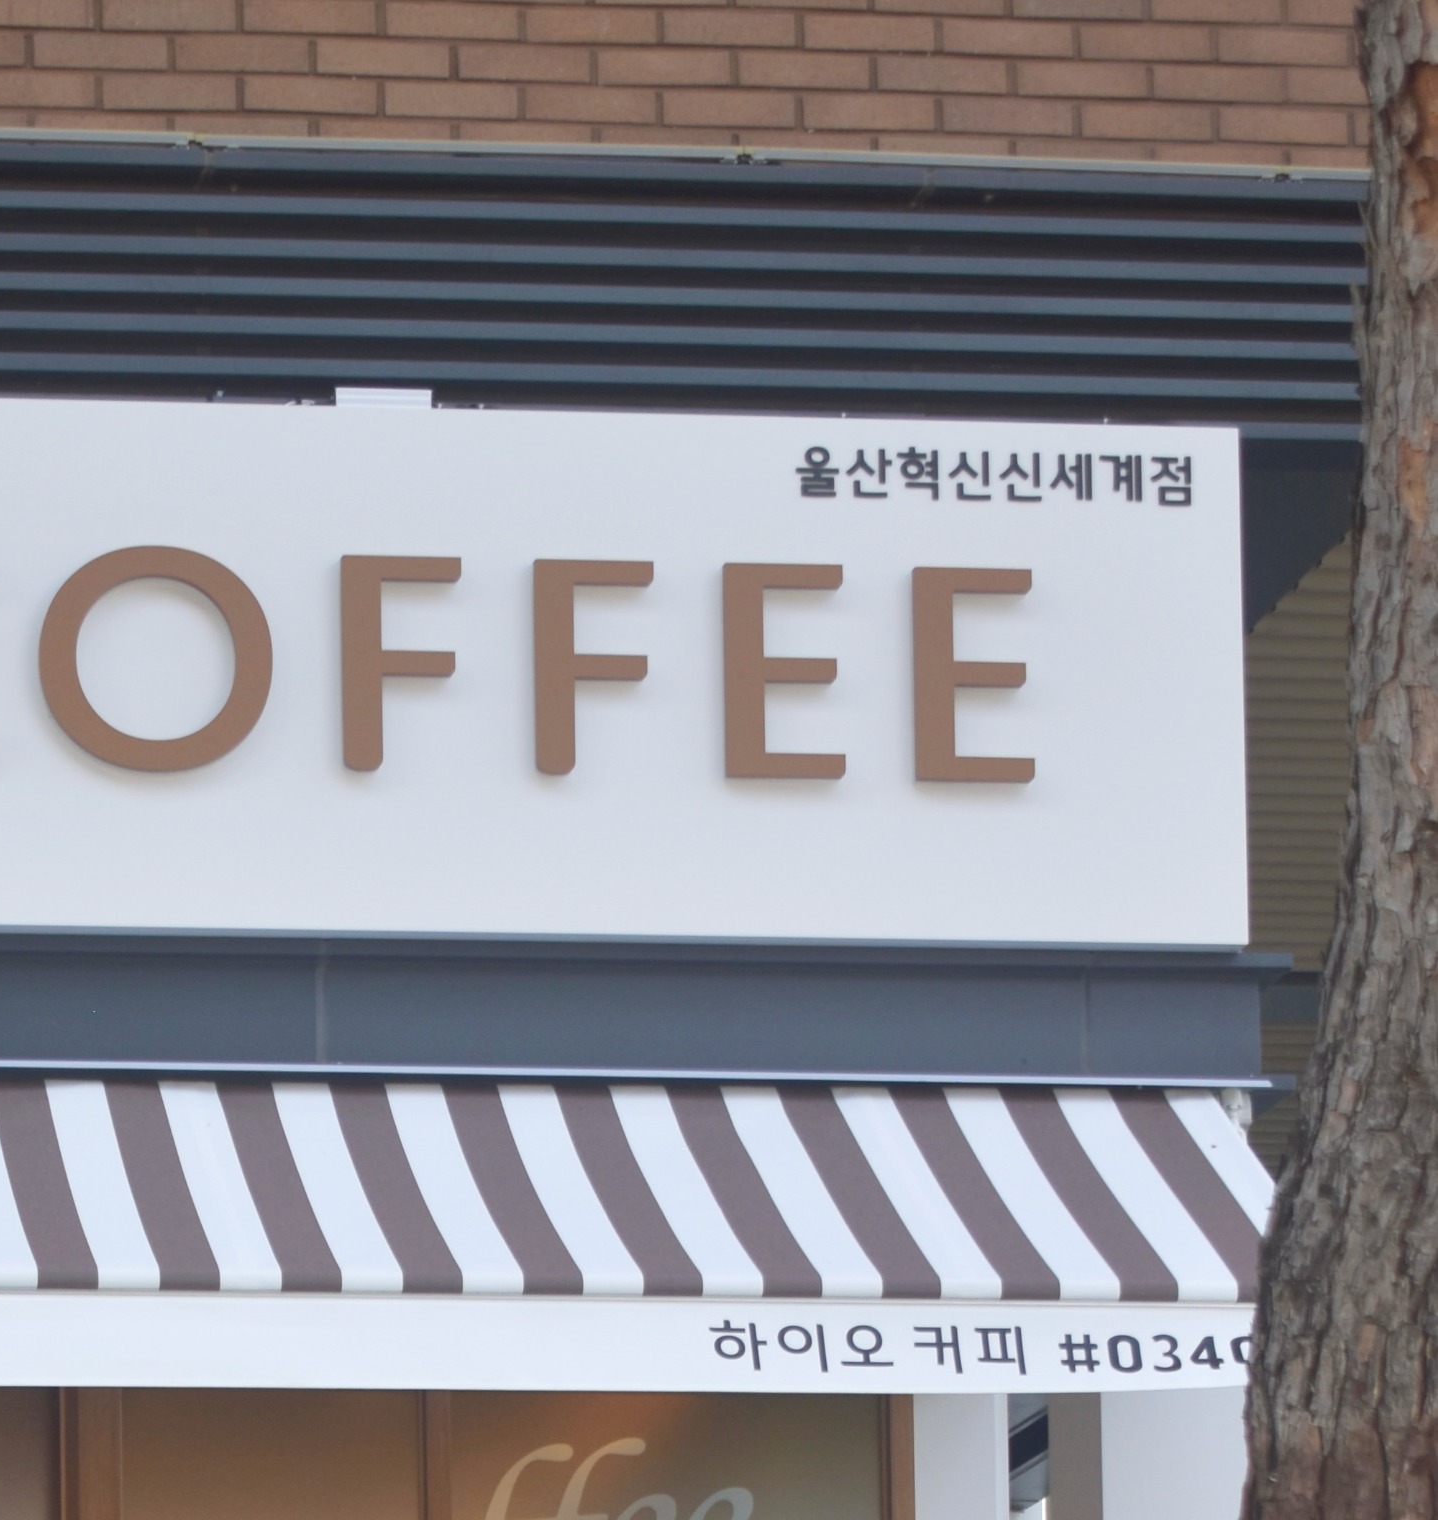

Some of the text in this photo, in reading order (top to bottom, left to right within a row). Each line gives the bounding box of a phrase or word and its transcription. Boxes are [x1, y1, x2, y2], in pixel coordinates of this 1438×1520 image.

[794, 446, 1194, 507] 울산혁신신세계점
[709, 1319, 894, 1373] 하이오
[912, 1325, 1028, 1376] 커피
